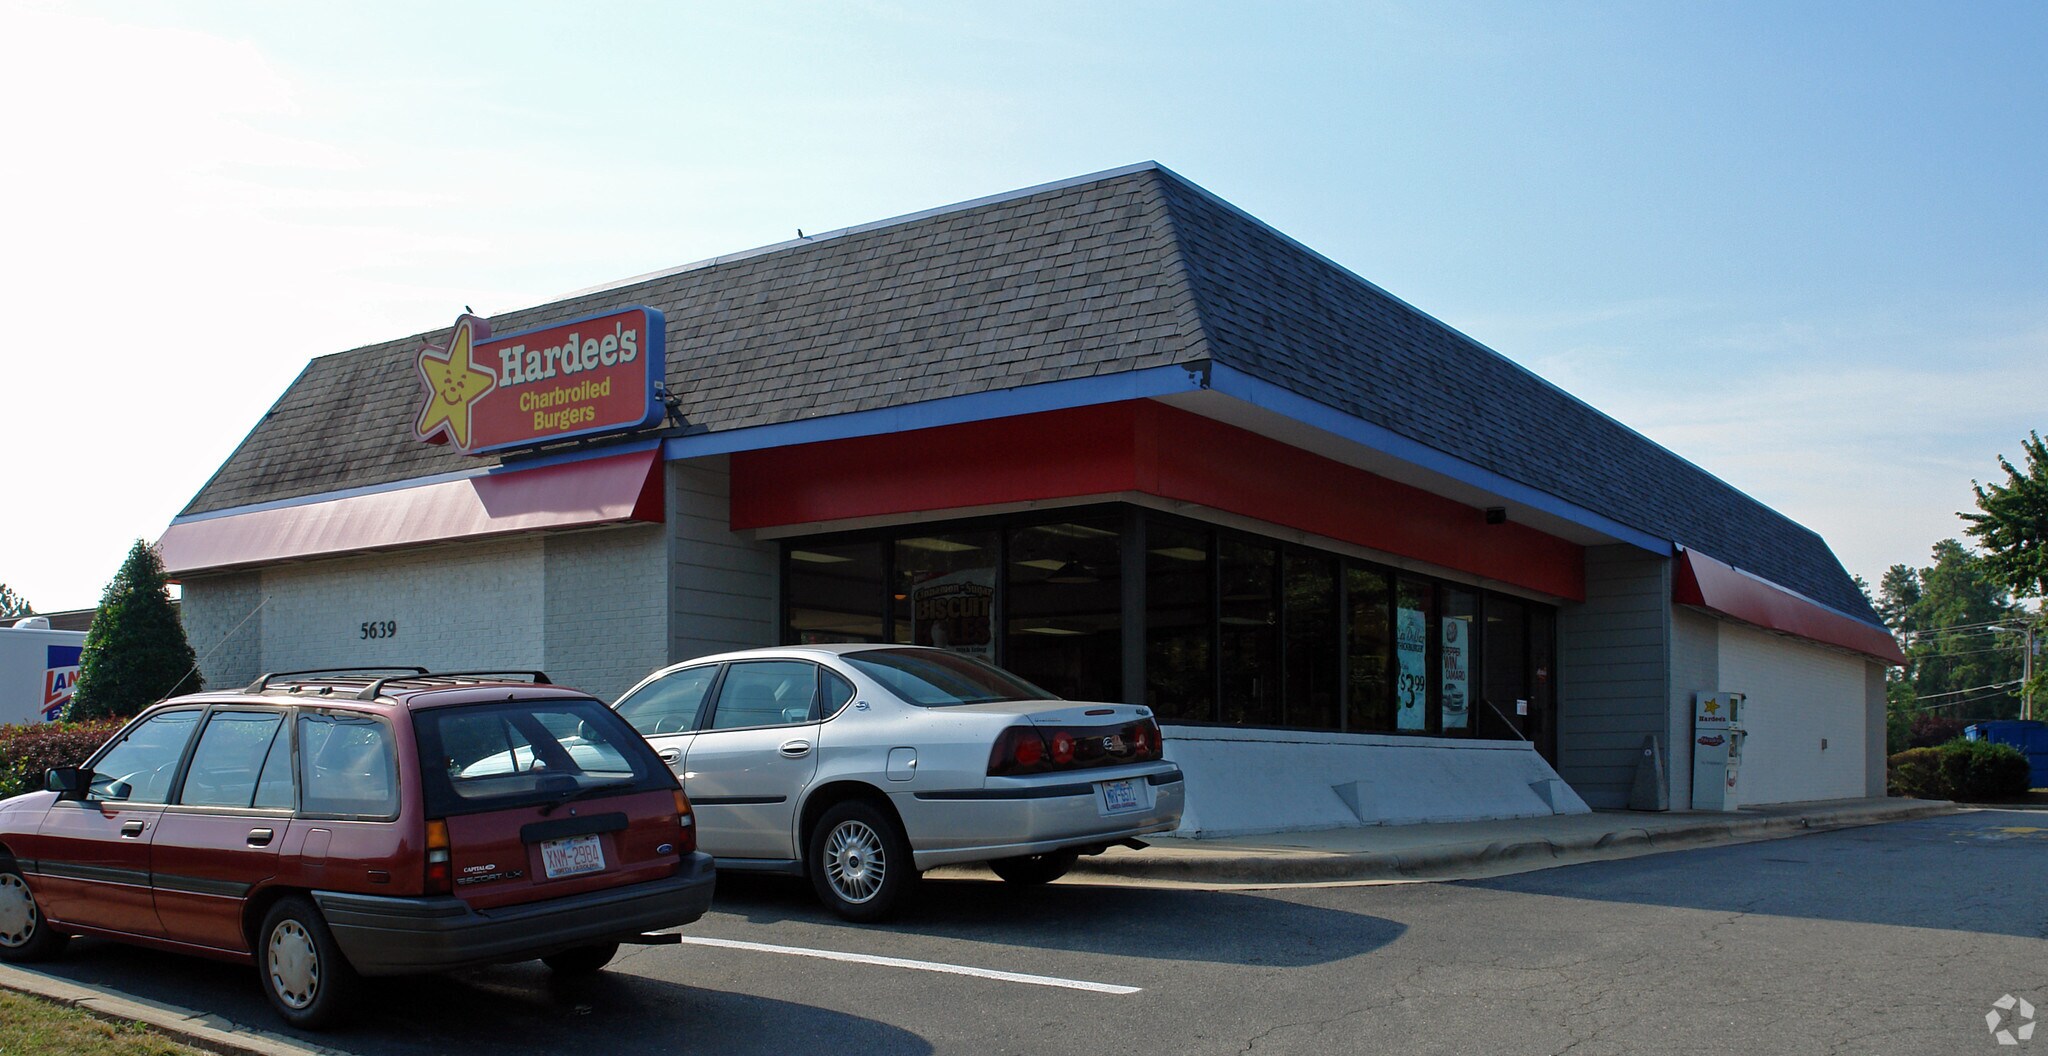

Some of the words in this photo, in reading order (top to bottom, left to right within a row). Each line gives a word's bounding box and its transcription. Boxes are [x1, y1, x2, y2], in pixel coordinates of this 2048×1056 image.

[499, 321, 638, 387] Hardee's
[519, 376, 611, 412] Charbroiled
[533, 403, 596, 431] Burgers
[915, 597, 990, 621] BISCUIT
[360, 620, 397, 640] 5639
[546, 844, 600, 869] XNM-2984
[457, 873, 503, 885] ESCORT
[505, 869, 523, 879] LX
[463, 865, 485, 873] CAPITAL
